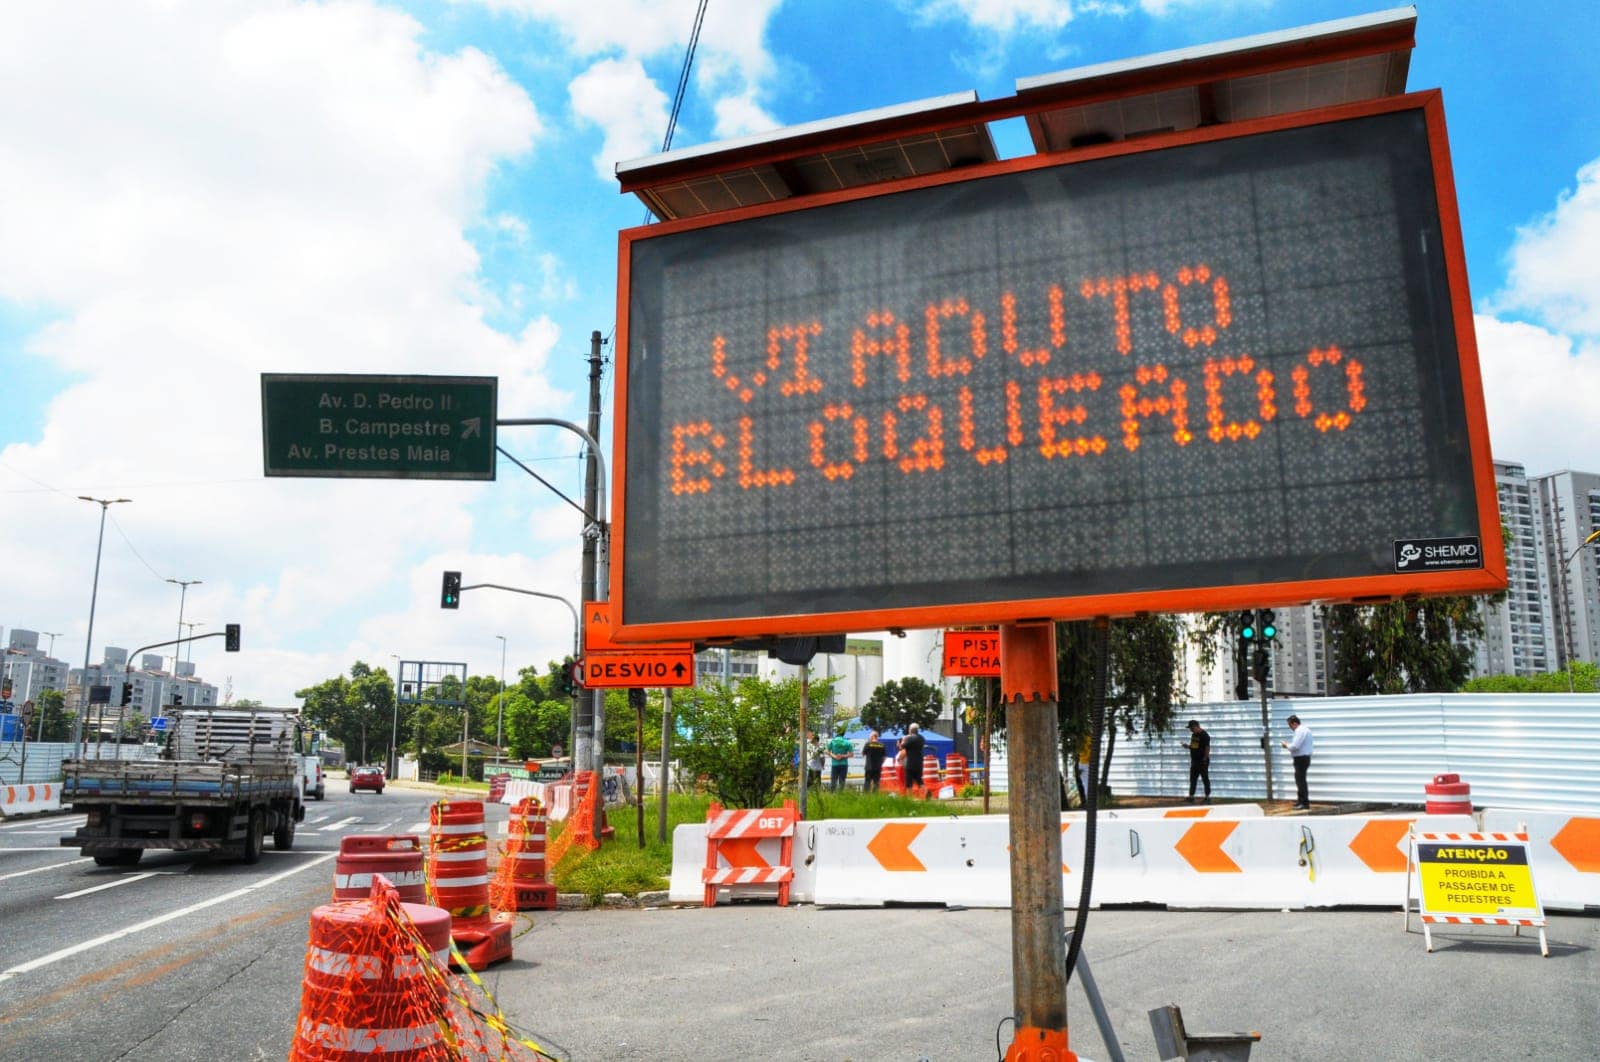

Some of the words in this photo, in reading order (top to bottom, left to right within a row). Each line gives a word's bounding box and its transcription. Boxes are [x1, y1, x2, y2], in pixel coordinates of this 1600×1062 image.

[711, 263, 1232, 403] VIADUTO
[318, 393, 347, 409] Av.
[354, 393, 372, 409] D.
[378, 393, 435, 410] Pedro
[670, 343, 1367, 495] BLOQUEADO
[319, 418, 339, 435] B.
[345, 418, 451, 439] Campestre
[287, 444, 318, 460] Av.
[325, 444, 400, 461] Prestes
[407, 445, 451, 462] Maia
[1424, 544, 1477, 558] SHEMPO
[963, 639, 998, 652] PIST
[949, 656, 1001, 669] FECHA
[590, 662, 668, 679] DESVIO
[759, 816, 785, 830] DET
[1436, 847, 1509, 862] ATENÇÃO
[1444, 868, 1496, 880] PROIBIDA
[1498, 870, 1506, 880] A
[1438, 881, 1498, 892] PASSAGEM
[1500, 883, 1516, 893] DE
[1447, 894, 1512, 905] PEDESTRES
